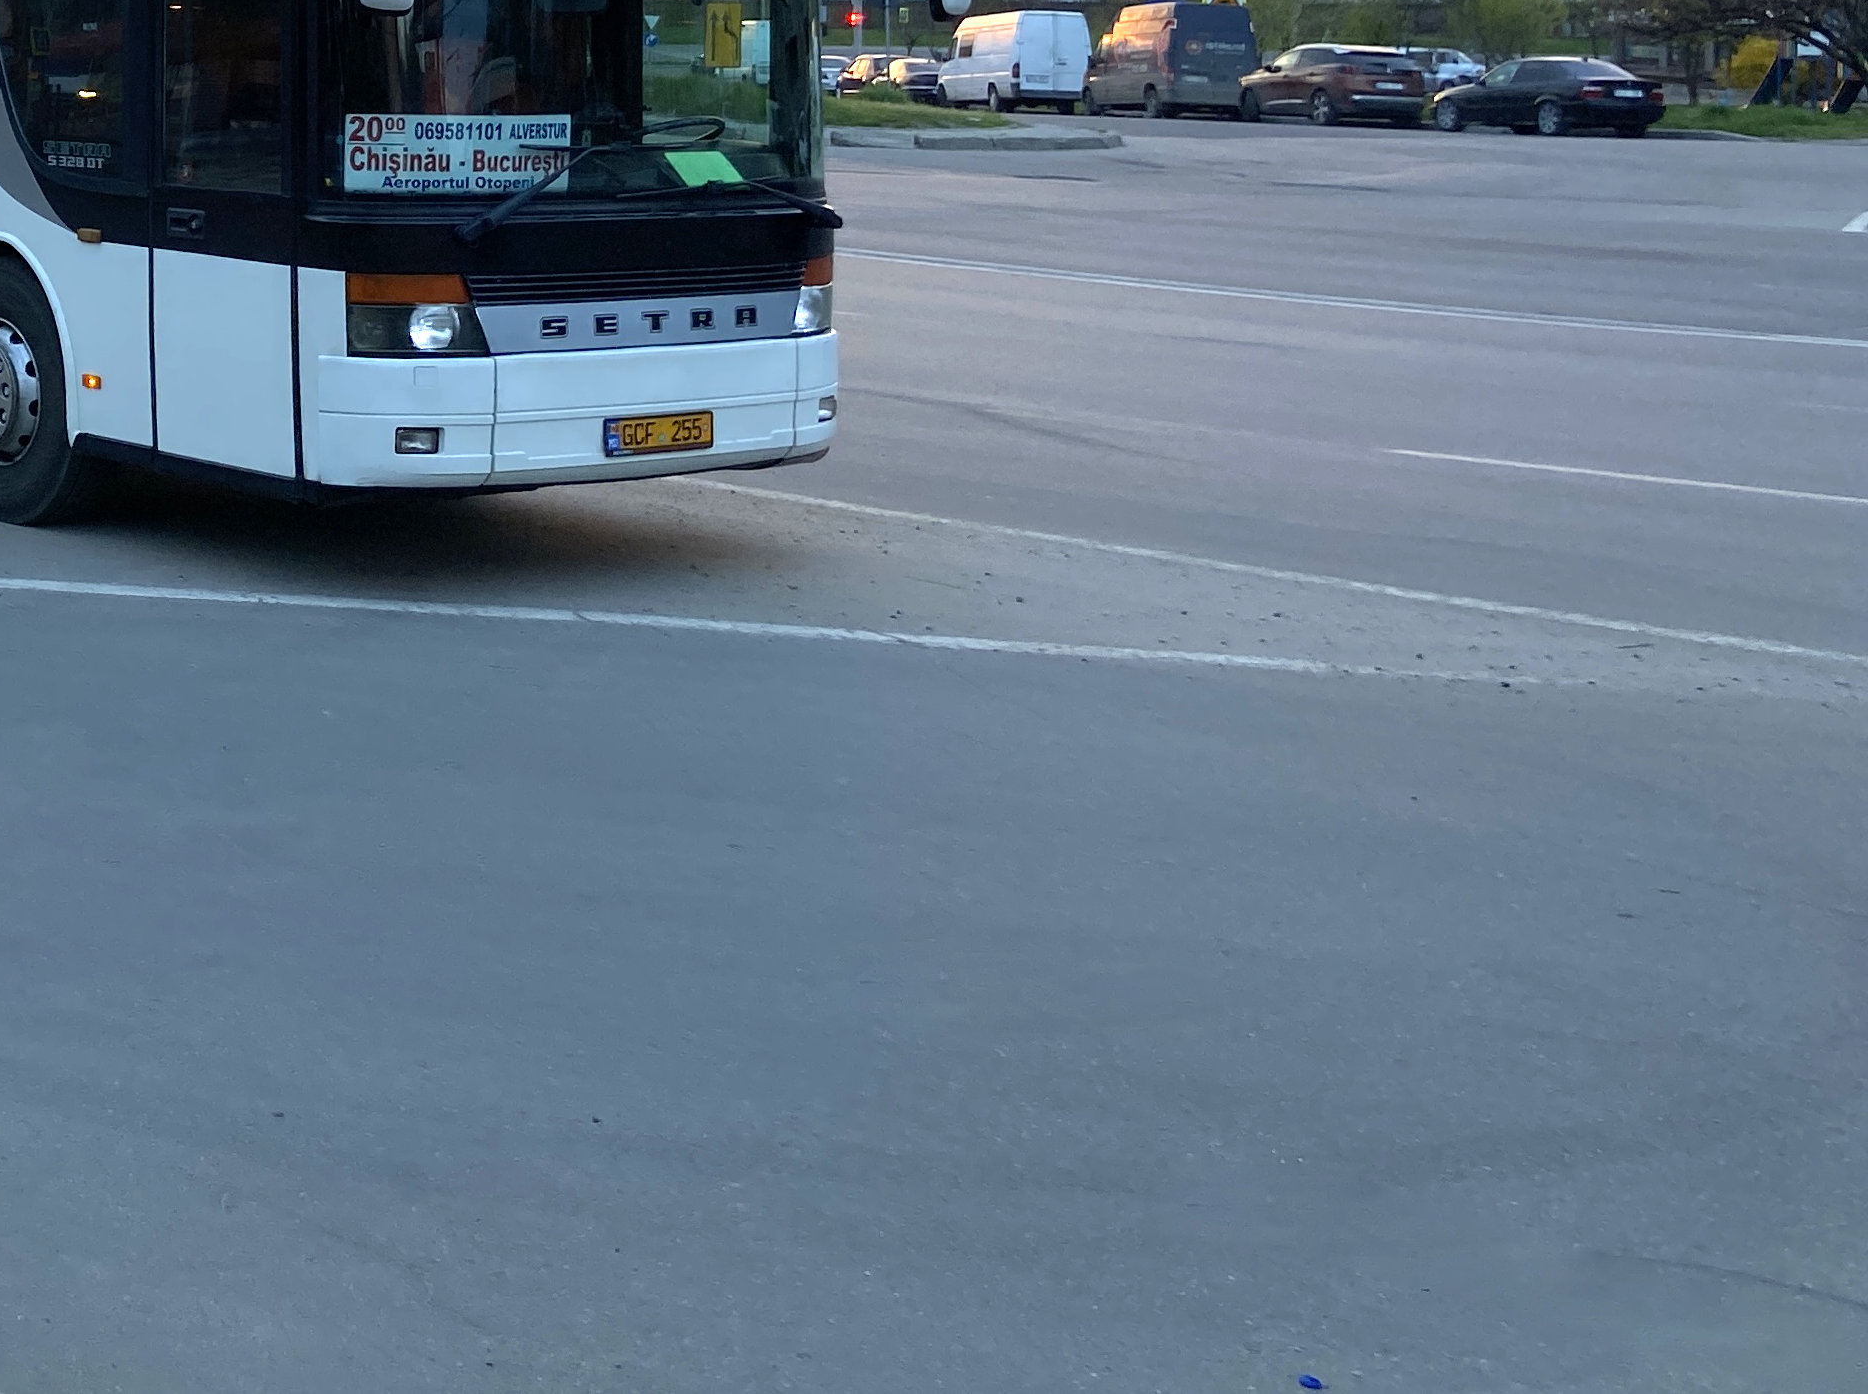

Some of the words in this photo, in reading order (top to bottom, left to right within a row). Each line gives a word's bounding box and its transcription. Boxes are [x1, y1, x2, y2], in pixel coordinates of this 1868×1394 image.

[414, 122, 503, 141] 069581101
[508, 123, 568, 140] ALVERSTUR
[381, 175, 469, 192] Aeroportul
[539, 305, 758, 339] SETRA
[622, 421, 657, 447] GCF
[670, 417, 703, 443] 255
